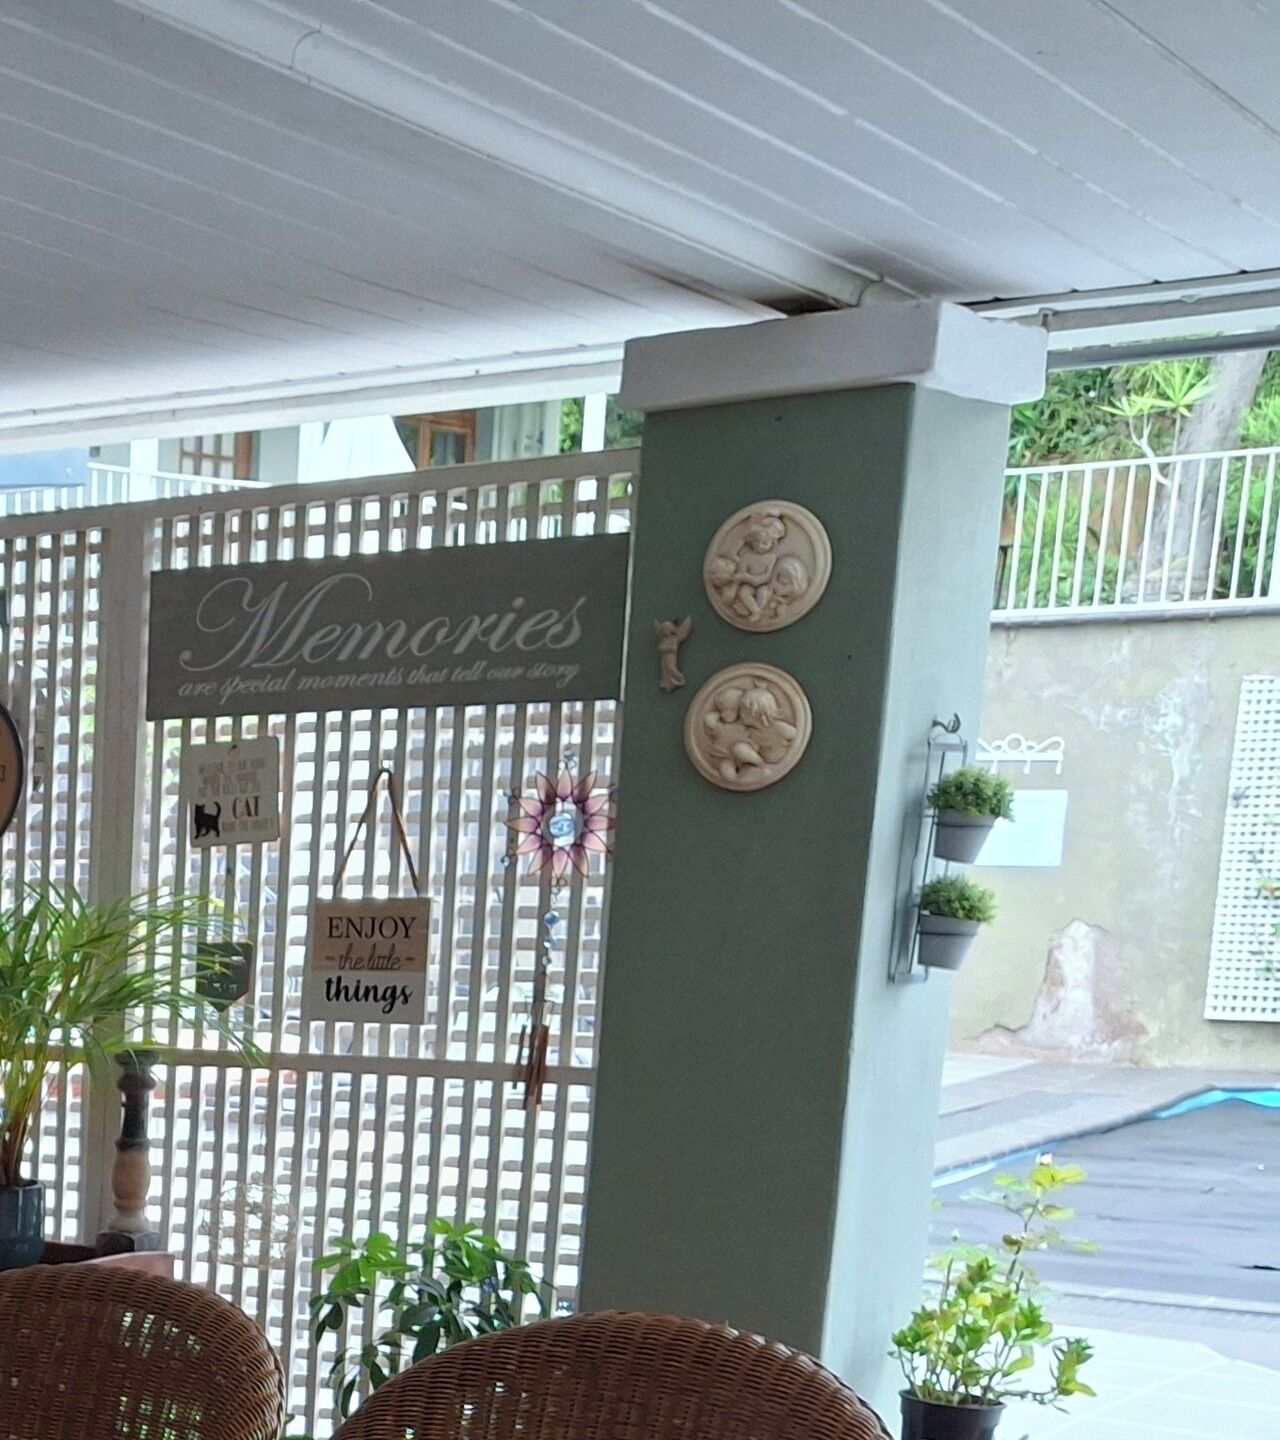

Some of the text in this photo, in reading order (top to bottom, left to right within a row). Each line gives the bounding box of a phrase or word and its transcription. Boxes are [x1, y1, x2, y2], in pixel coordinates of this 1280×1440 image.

[179, 572, 588, 672] Memories
[178, 659, 581, 706] are special moments that tell our story
[0, 764, 6, 783] 3
[231, 795, 261, 820] CAT
[327, 915, 417, 939] ENJOY
[337, 942, 401, 971] the little
[324, 975, 415, 1015] things
